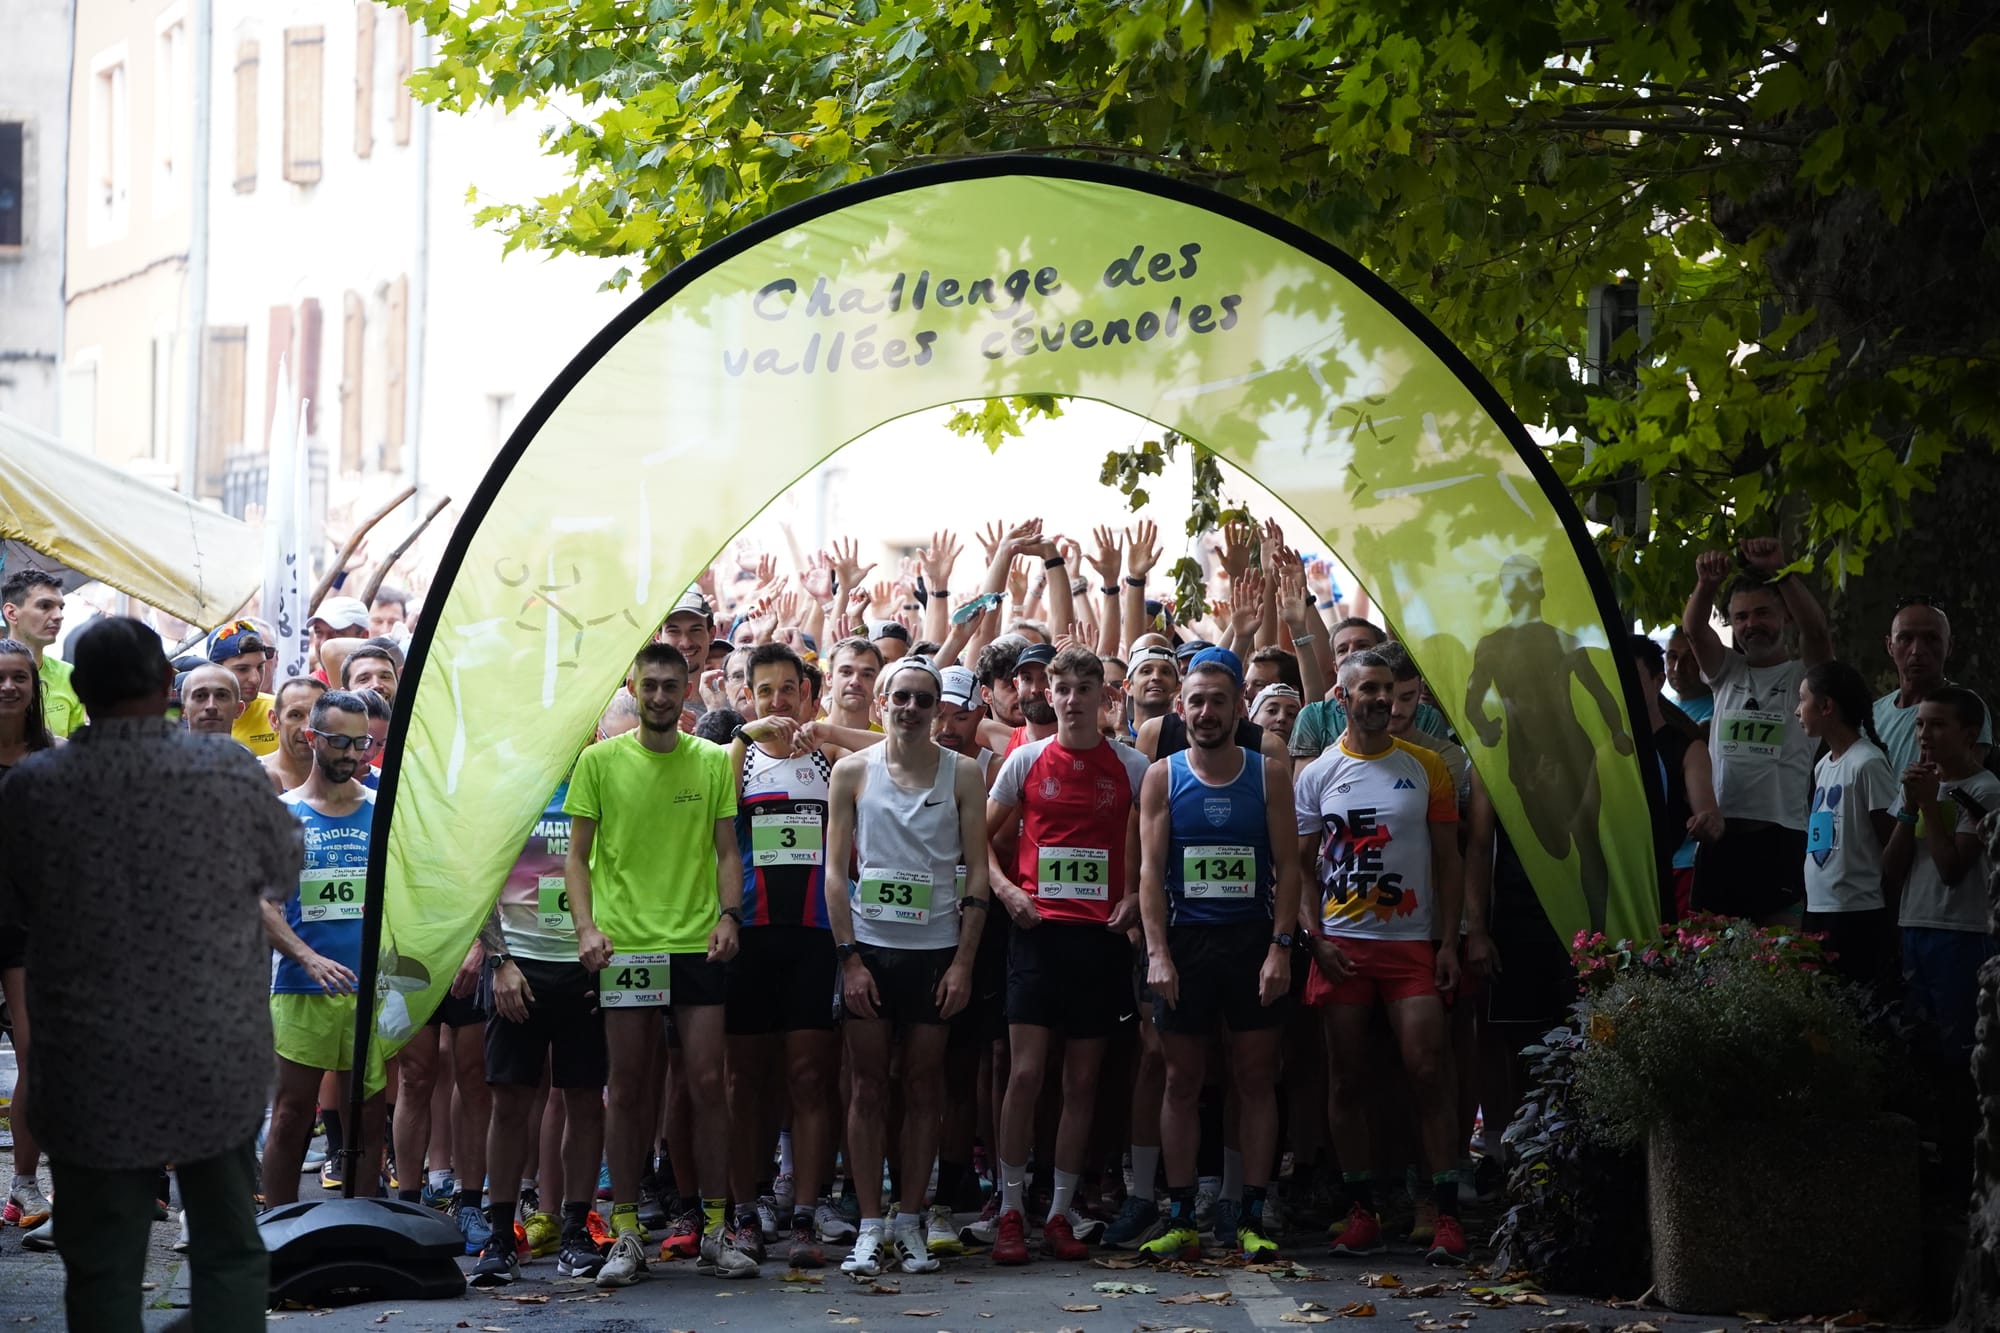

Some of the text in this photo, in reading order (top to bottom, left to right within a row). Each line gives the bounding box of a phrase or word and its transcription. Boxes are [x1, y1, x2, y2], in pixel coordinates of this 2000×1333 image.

[753, 242, 1201, 321] Challenge des
[723, 294, 1242, 377] vallées cévenoles
[1729, 721, 1775, 742] 117
[780, 827, 797, 848] 3
[1812, 828, 1821, 842] 5
[1049, 861, 1099, 882] 113
[1194, 859, 1246, 881] 134
[319, 881, 354, 903] 46
[878, 882, 913, 905] 53
[616, 967, 651, 989] 43
